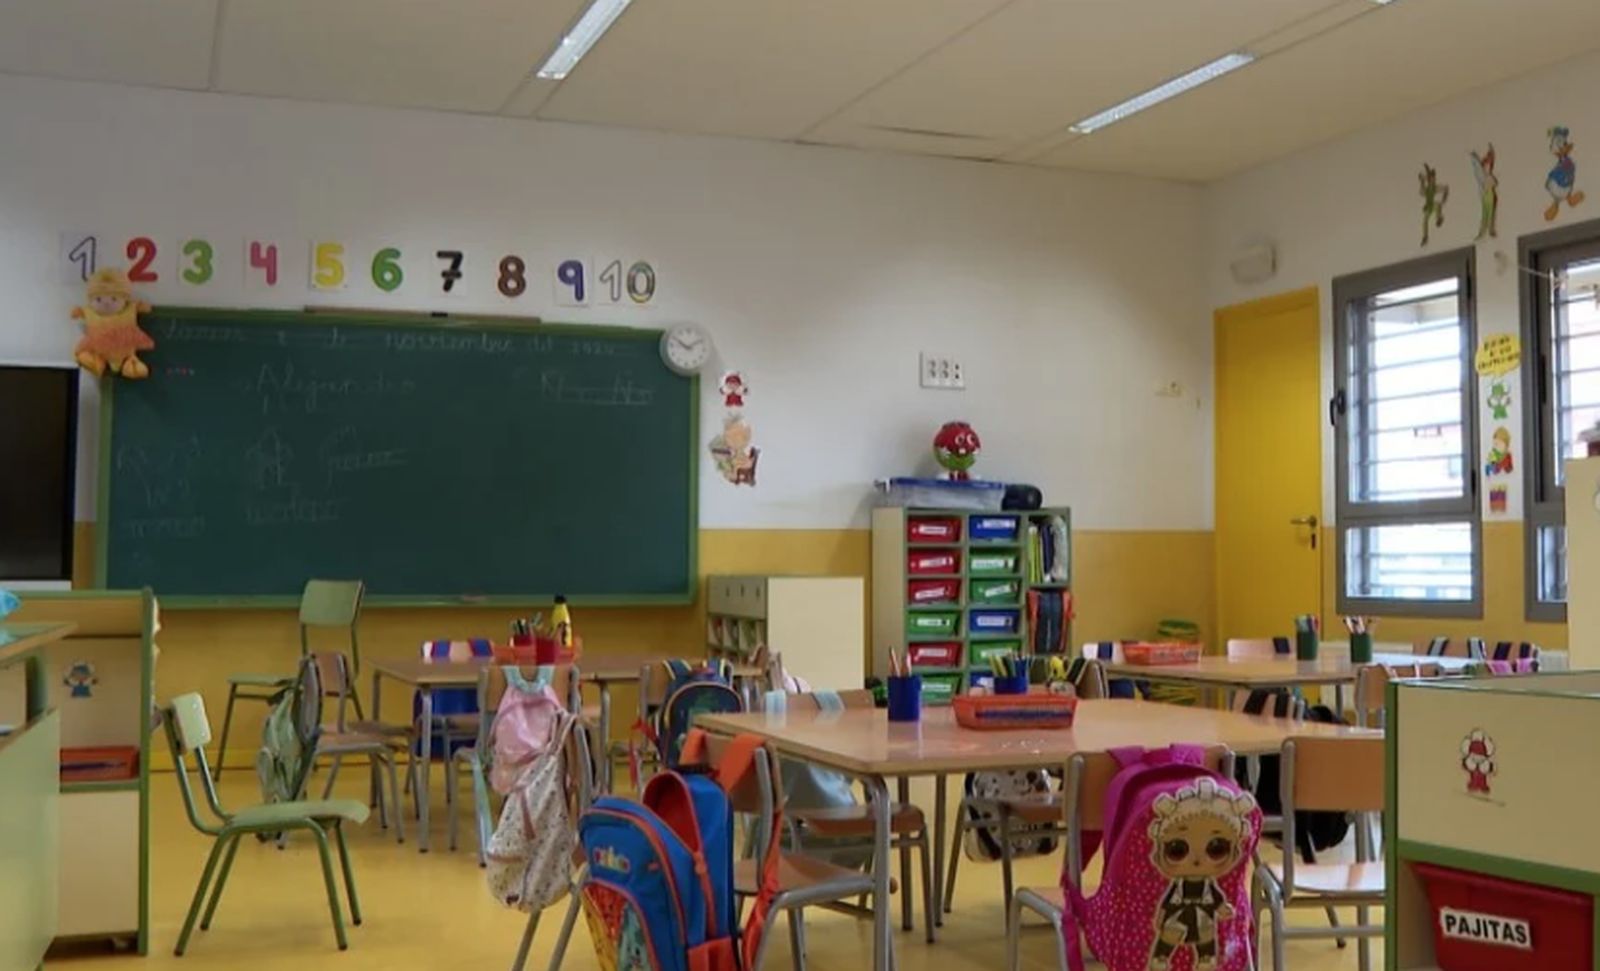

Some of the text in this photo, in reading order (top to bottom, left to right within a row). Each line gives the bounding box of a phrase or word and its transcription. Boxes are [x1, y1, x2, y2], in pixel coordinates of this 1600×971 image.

[69, 236, 656, 304] 1 2 3 4 5 6 7 8 9 10
[1445, 914, 1527, 944] PAJITAS
